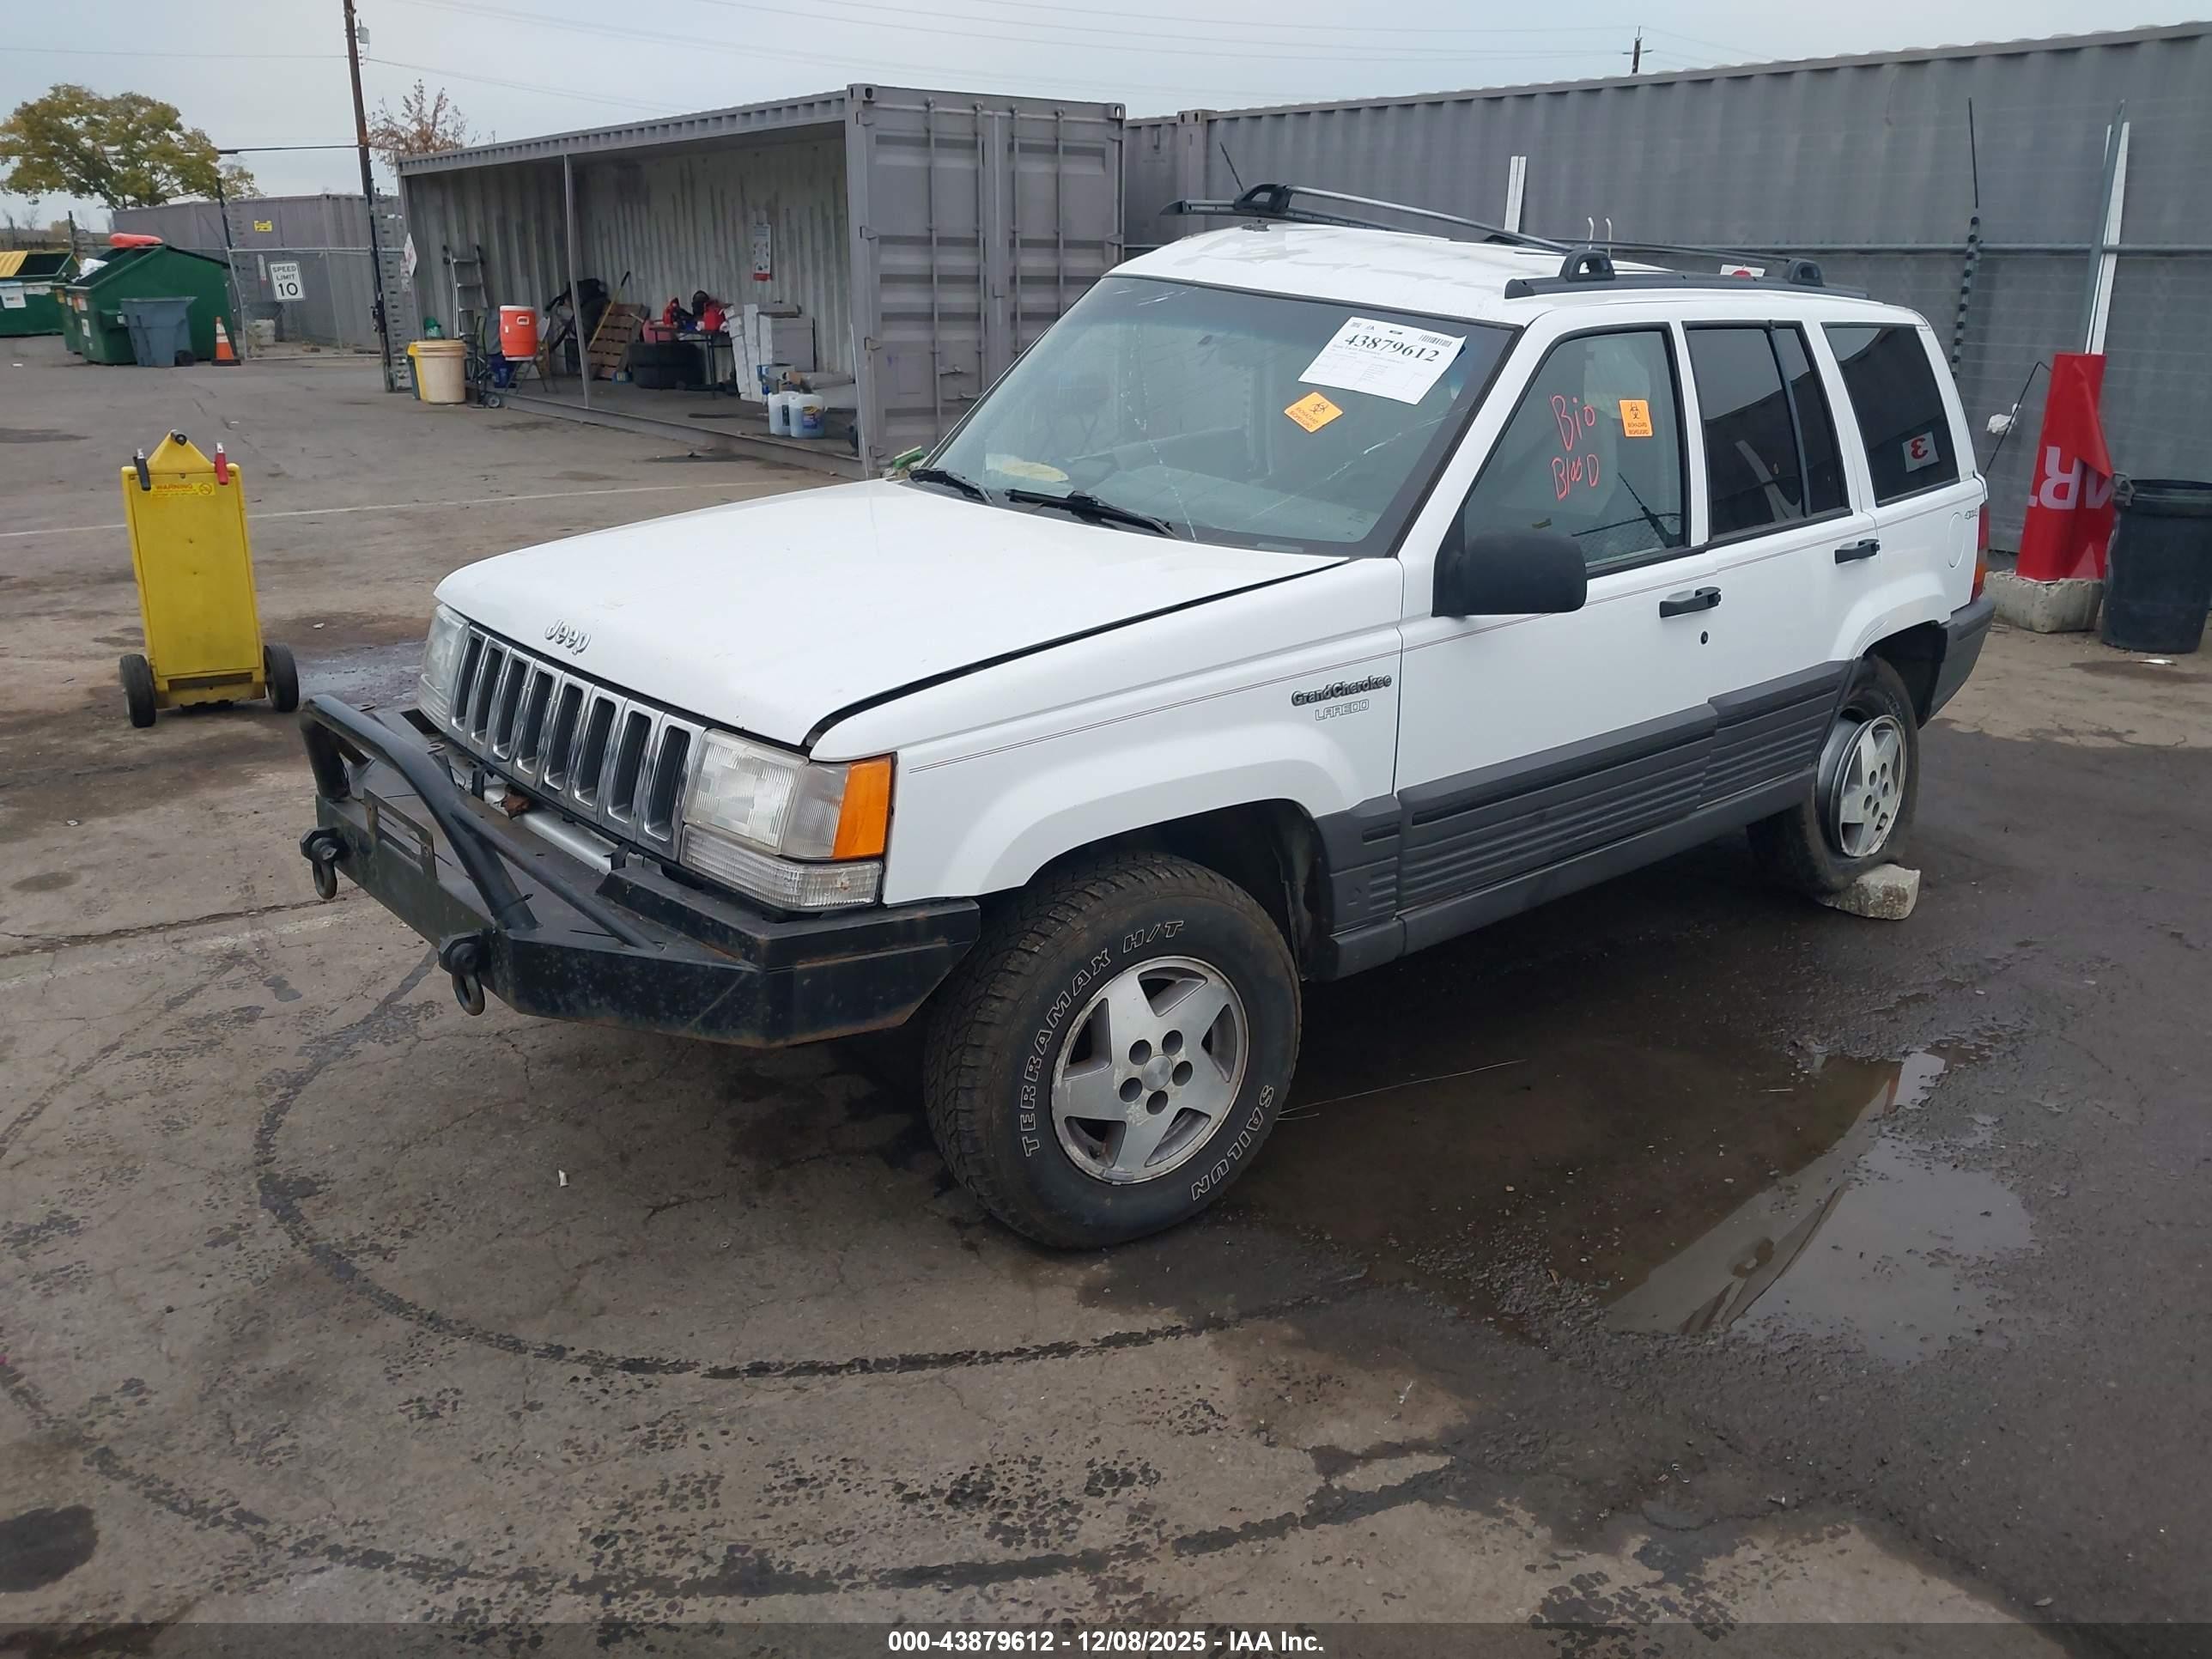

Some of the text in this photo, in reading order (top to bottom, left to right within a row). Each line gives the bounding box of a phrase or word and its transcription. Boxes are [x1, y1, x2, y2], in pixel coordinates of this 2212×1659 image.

[272, 264, 297, 273] SPEED
[277, 282, 299, 297] 10
[1344, 332, 1441, 363] 43879612
[1549, 394, 1596, 451] Bio
[544, 618, 592, 656] Jeep
[1315, 698, 1370, 721] LAREDO
[1019, 920, 1184, 1158] TERRAMAX H/T
[1190, 1085, 1274, 1202] SAILUN
